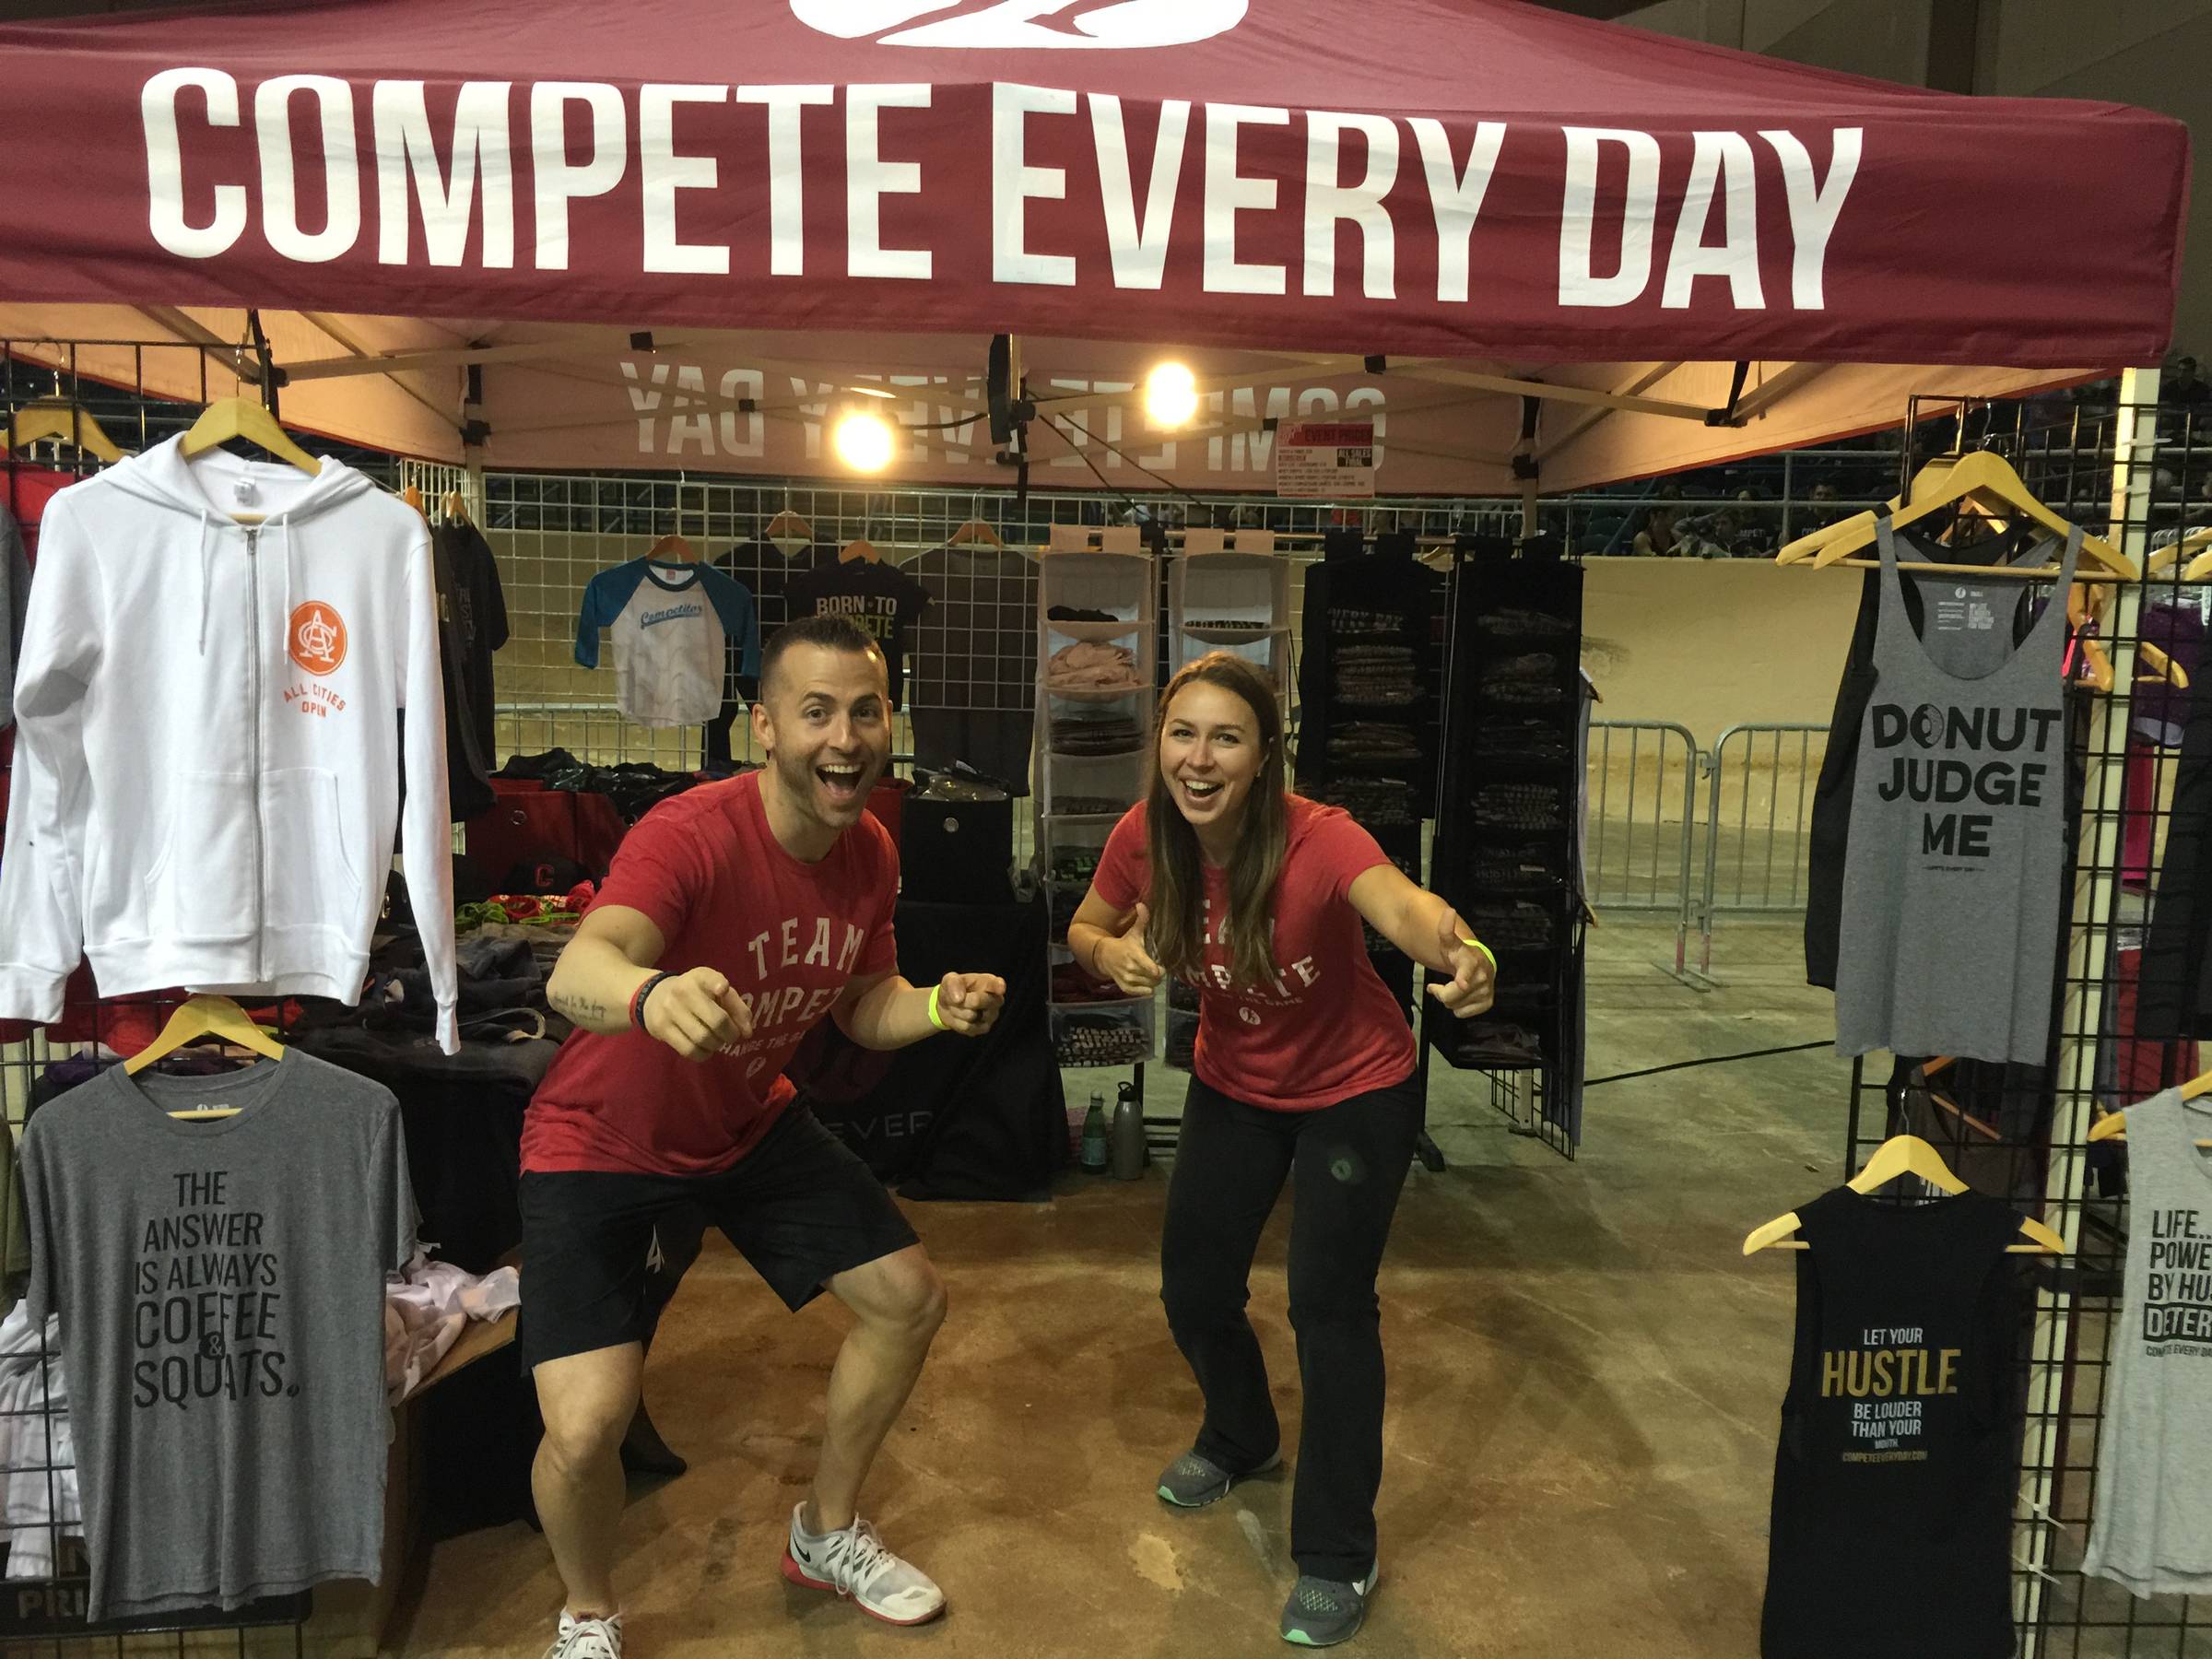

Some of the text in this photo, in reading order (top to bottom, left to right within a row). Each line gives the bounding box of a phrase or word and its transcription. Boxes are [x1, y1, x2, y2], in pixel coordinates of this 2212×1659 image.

[141, 66, 1863, 311] COMPETE EVERY DAY
[816, 595, 898, 616] BORN TO
[853, 615, 895, 640] PETE
[283, 683, 347, 712] ALL CITIES
[301, 700, 327, 718] OPEN
[1872, 702, 2063, 752] DONUT
[1878, 757, 2048, 807] JUDGE
[1922, 813, 1994, 857] ME
[534, 863, 555, 888] C
[748, 916, 865, 981] TEAM
[719, 1039, 765, 1057] HANGE
[173, 1171, 229, 1207] THE
[142, 1212, 265, 1253] ANSWER
[135, 1253, 278, 1295] IS ALWAYS
[2147, 1273, 2212, 1302] BY HU
[135, 1291, 281, 1350] COFFEE
[1864, 1327, 1924, 1346] LET YOUR
[134, 1348, 300, 1411] SQUATS.
[1821, 1348, 1961, 1397] HUSTLE
[1853, 1401, 1922, 1420] BE LOUDER
[1851, 1419, 1922, 1438] THAN YOUR
[18, 1588, 85, 1618] PRI
